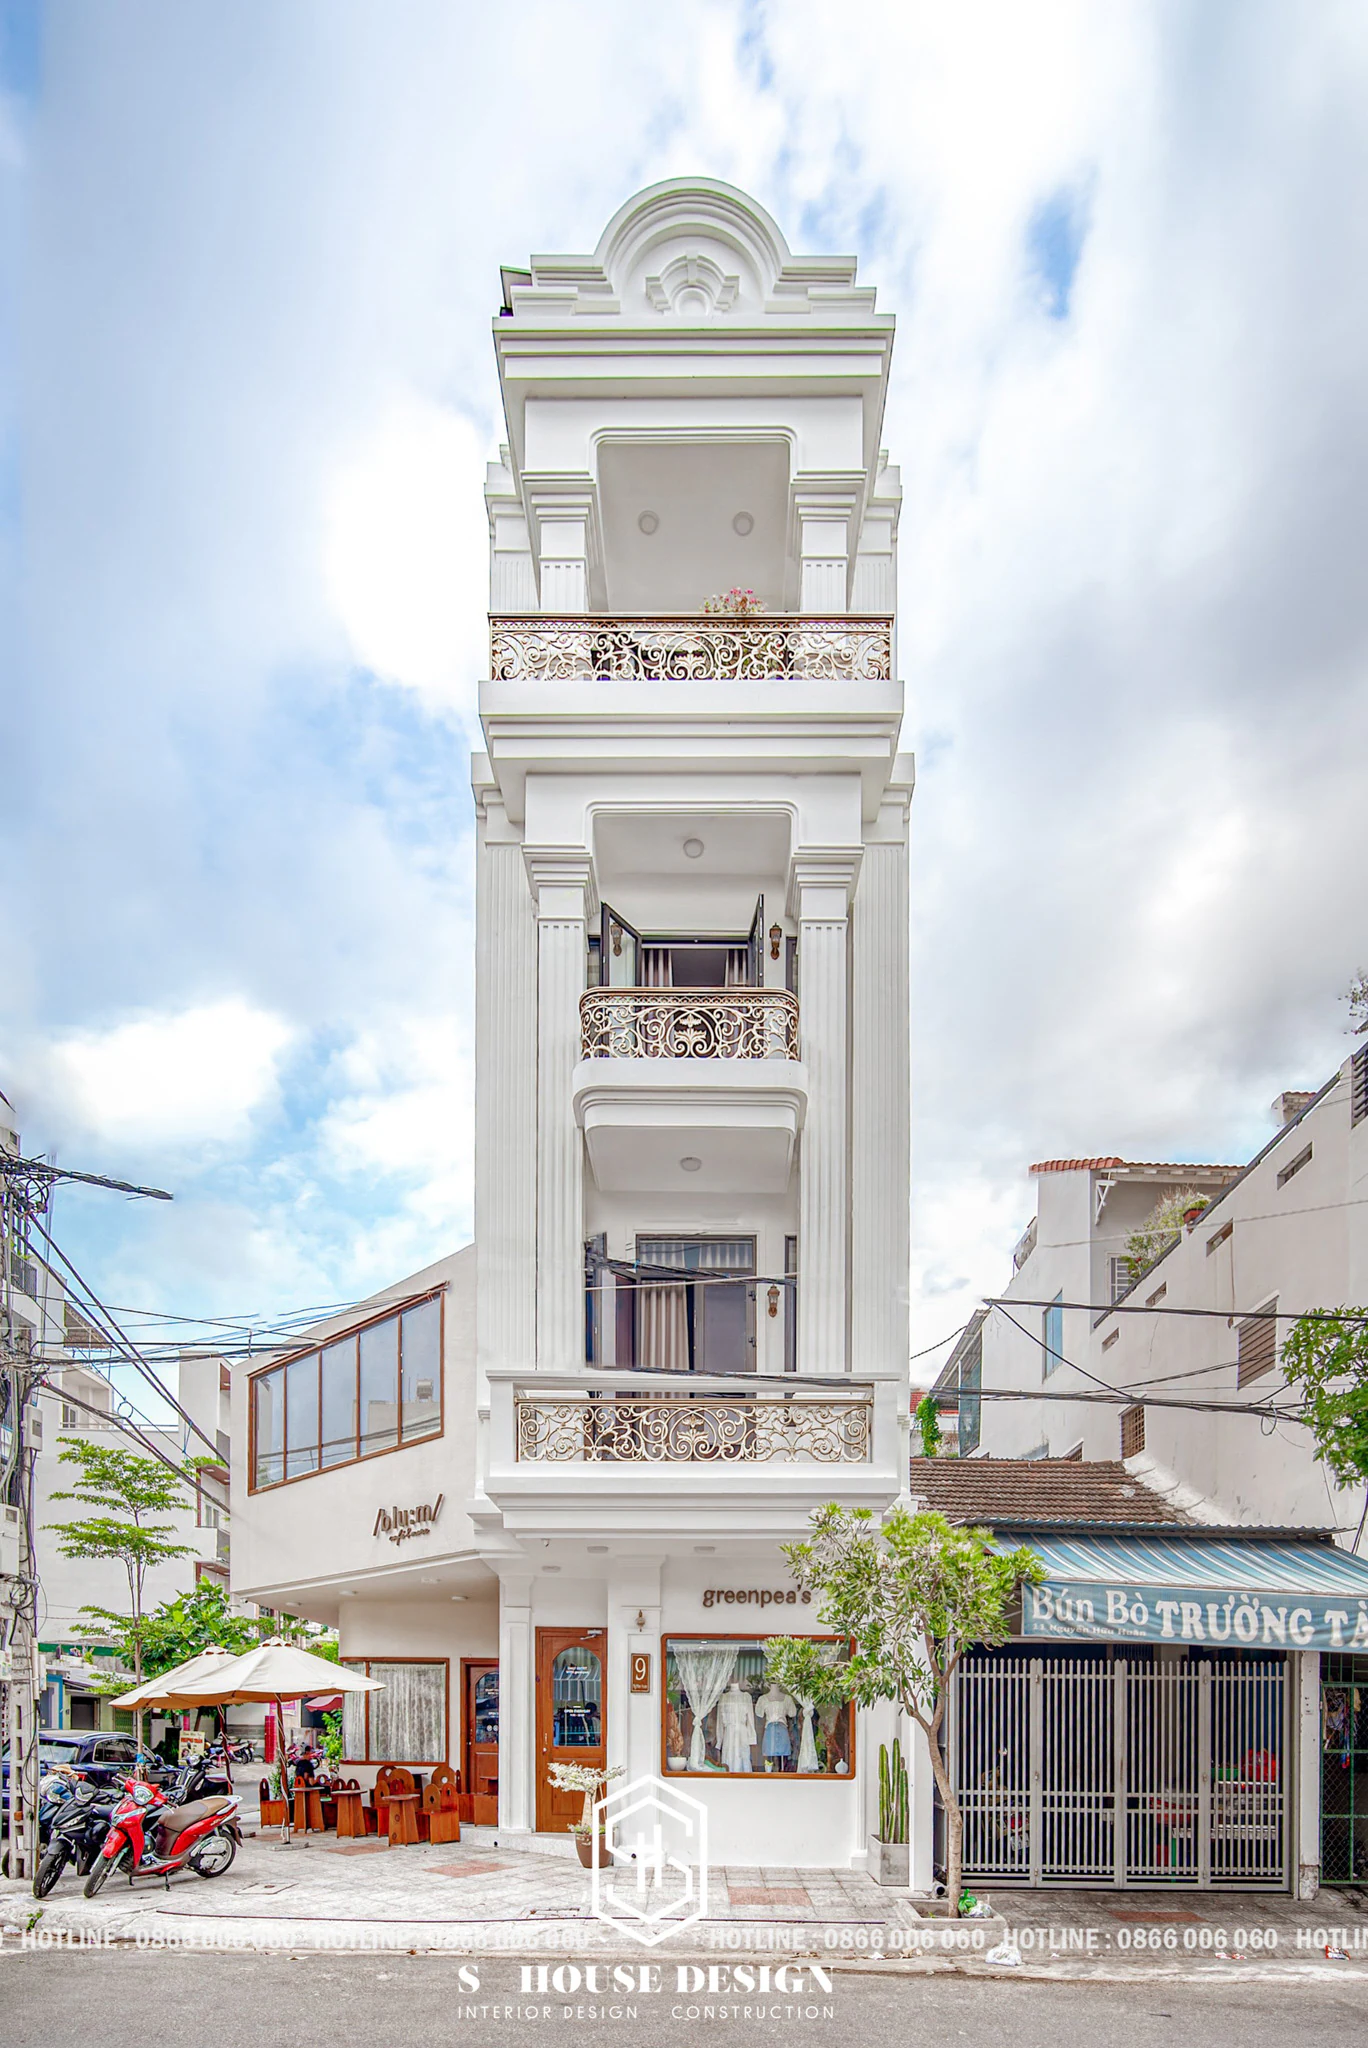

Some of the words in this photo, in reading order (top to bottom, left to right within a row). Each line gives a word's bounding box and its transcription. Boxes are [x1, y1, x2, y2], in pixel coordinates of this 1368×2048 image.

[702, 1583, 812, 1608] greenpea's
[1032, 1586, 1095, 1622] Bún
[1105, 1590, 1149, 1625] Bò
[1155, 1593, 1316, 1646] TRƯỜNG
[634, 1657, 646, 1681] 9
